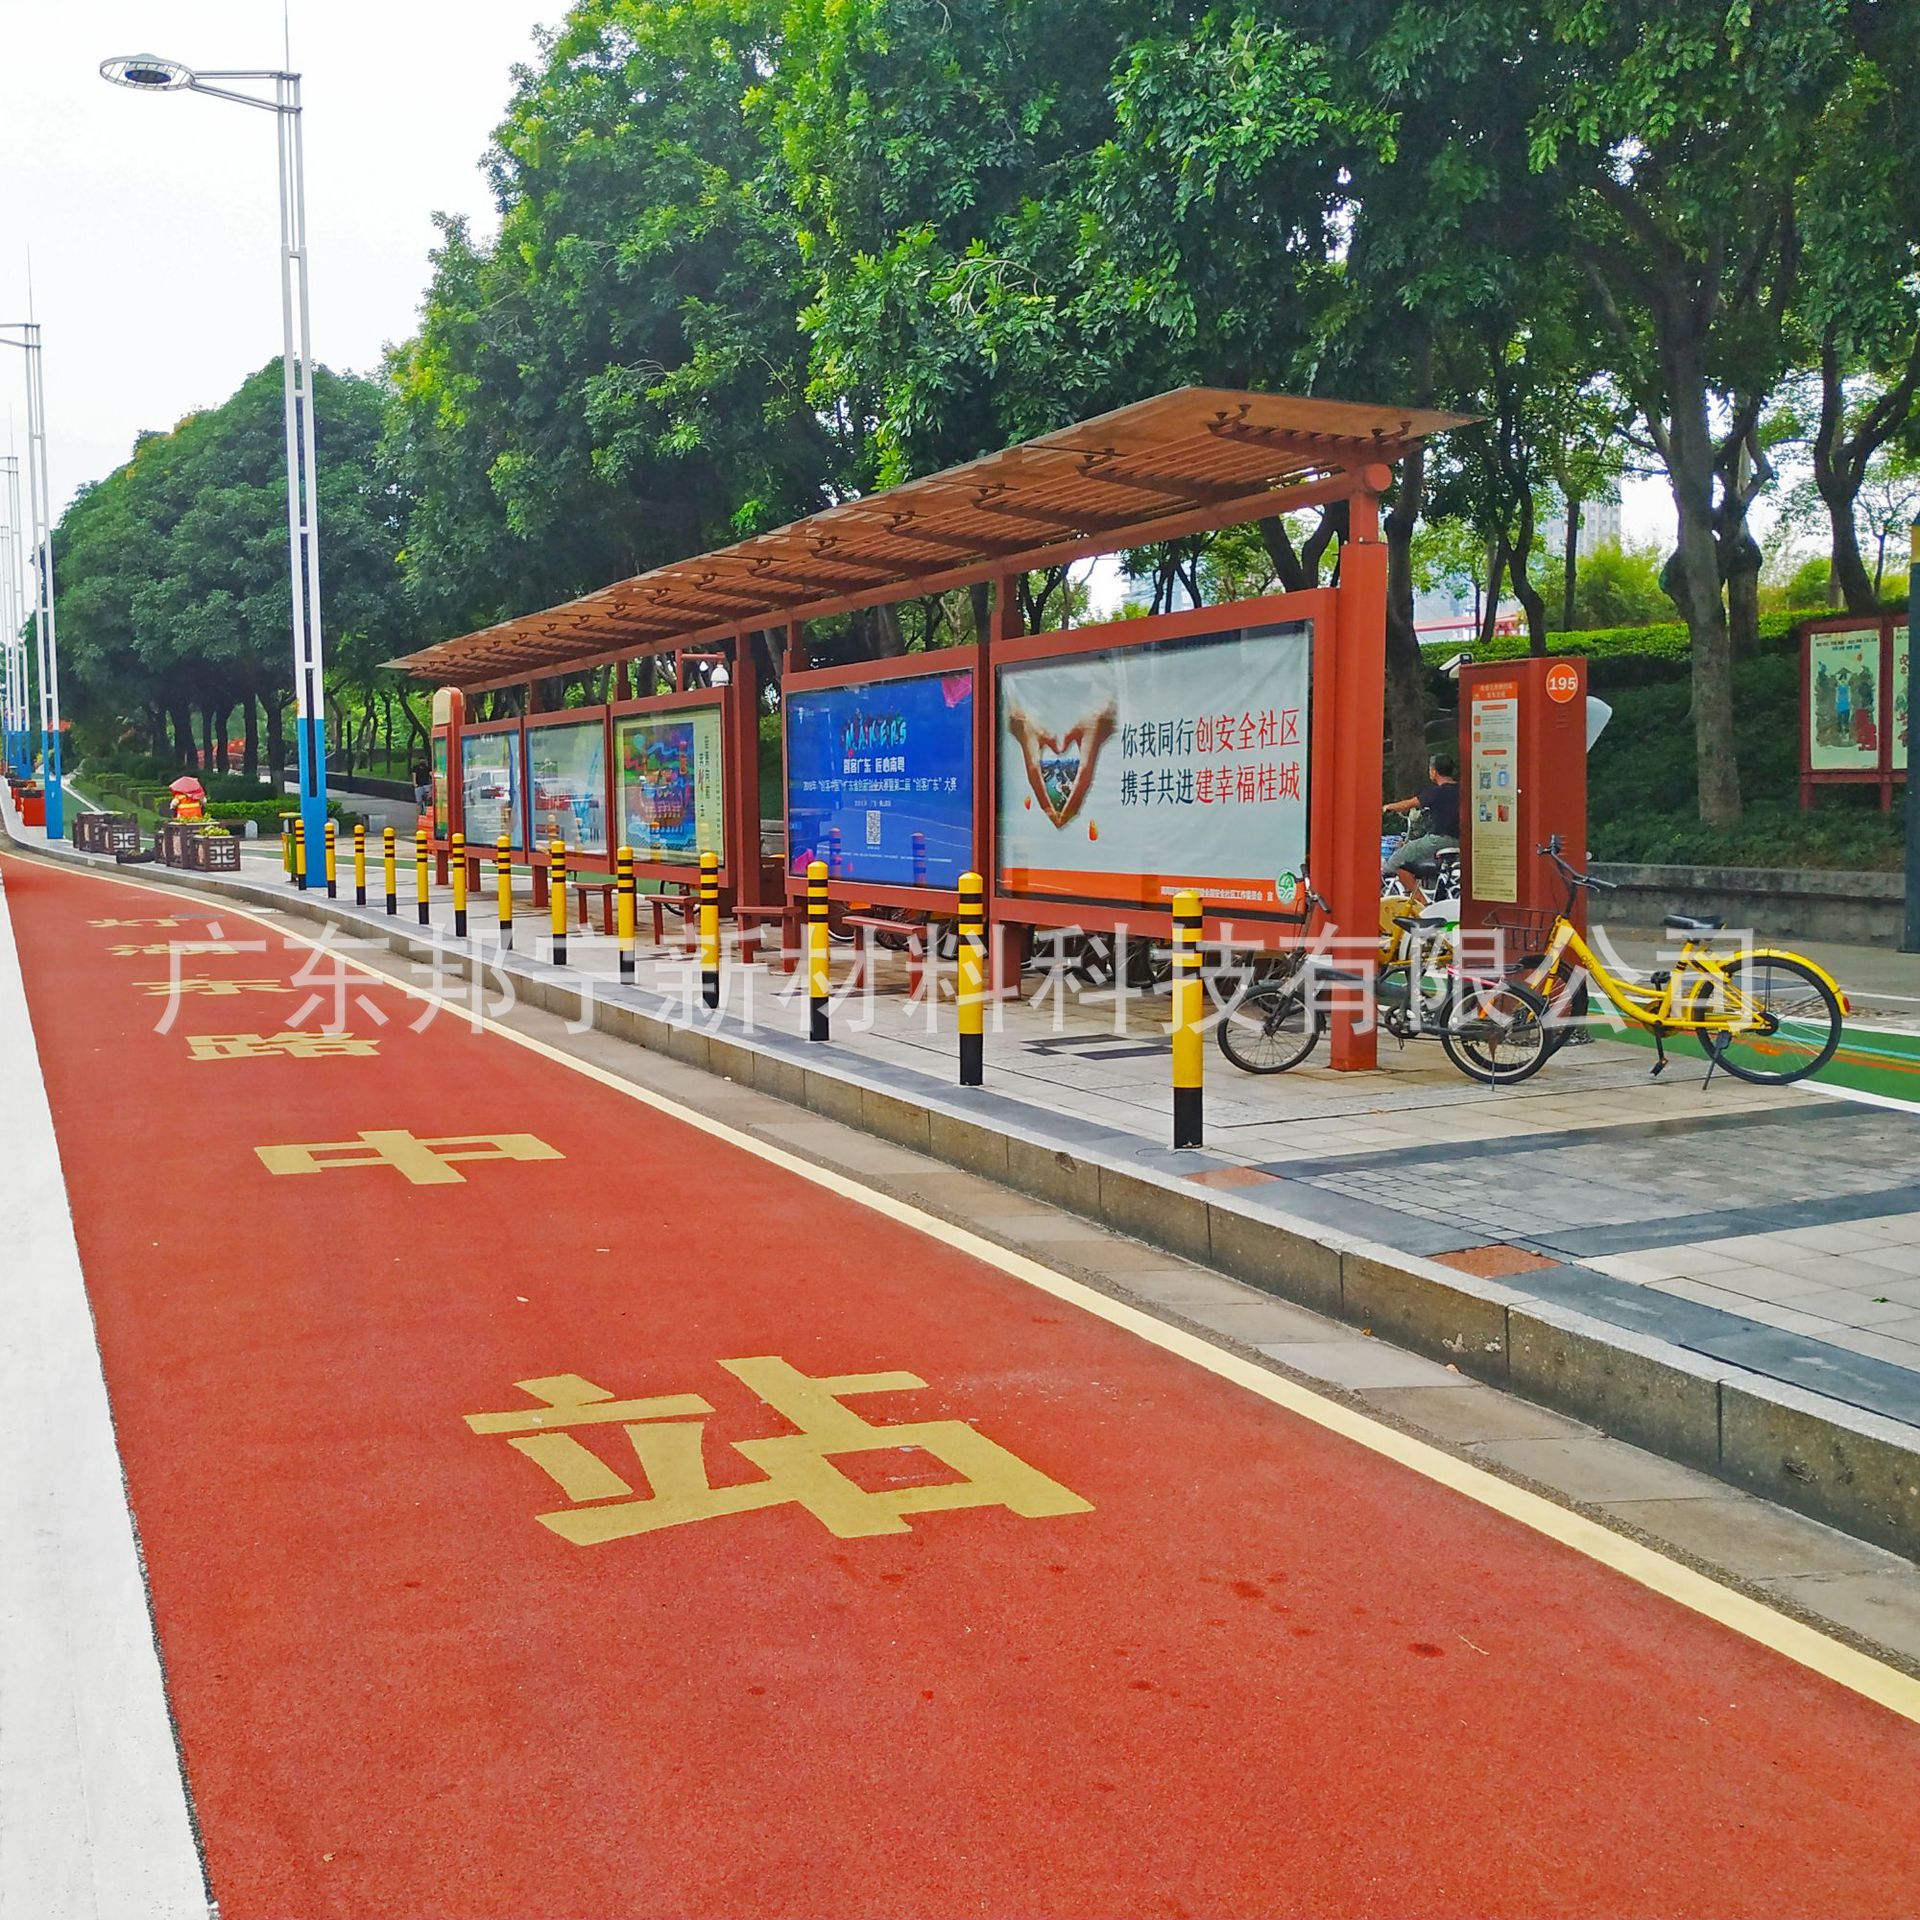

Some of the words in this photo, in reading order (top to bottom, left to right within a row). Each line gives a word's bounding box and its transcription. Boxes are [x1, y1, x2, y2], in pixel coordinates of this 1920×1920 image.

[1549, 676, 1577, 691] 195
[846, 720, 907, 751] MAKERS
[1121, 709, 1300, 759] 你我同行创安全社区
[1121, 761, 1300, 806] 携手共进建幸福桂城
